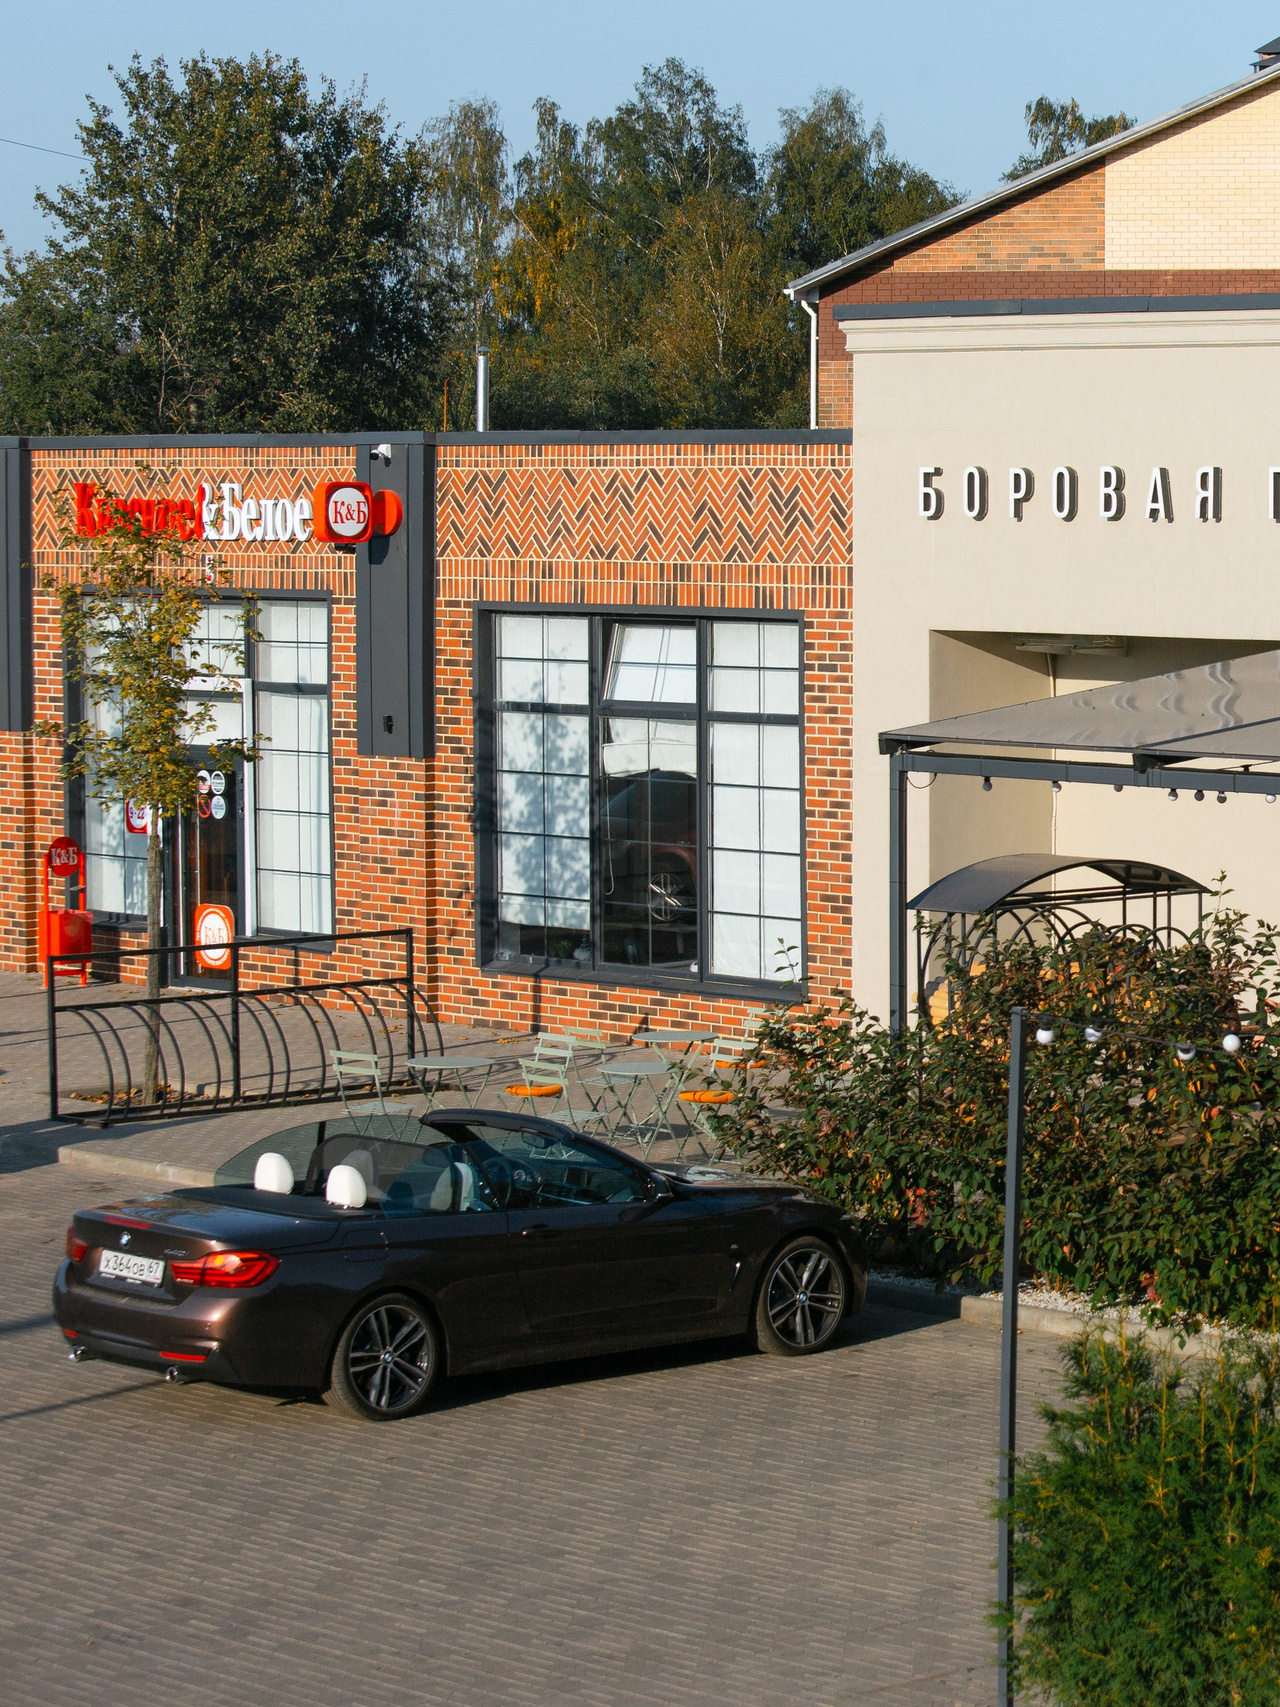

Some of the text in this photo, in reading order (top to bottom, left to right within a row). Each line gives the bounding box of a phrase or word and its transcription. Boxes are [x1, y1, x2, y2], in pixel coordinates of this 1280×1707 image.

[918, 466, 1223, 523] БОРОВАЯ
[333, 500, 367, 524] К&Б
[51, 847, 78, 866] К&Б
[148, 1261, 160, 1274] 67
